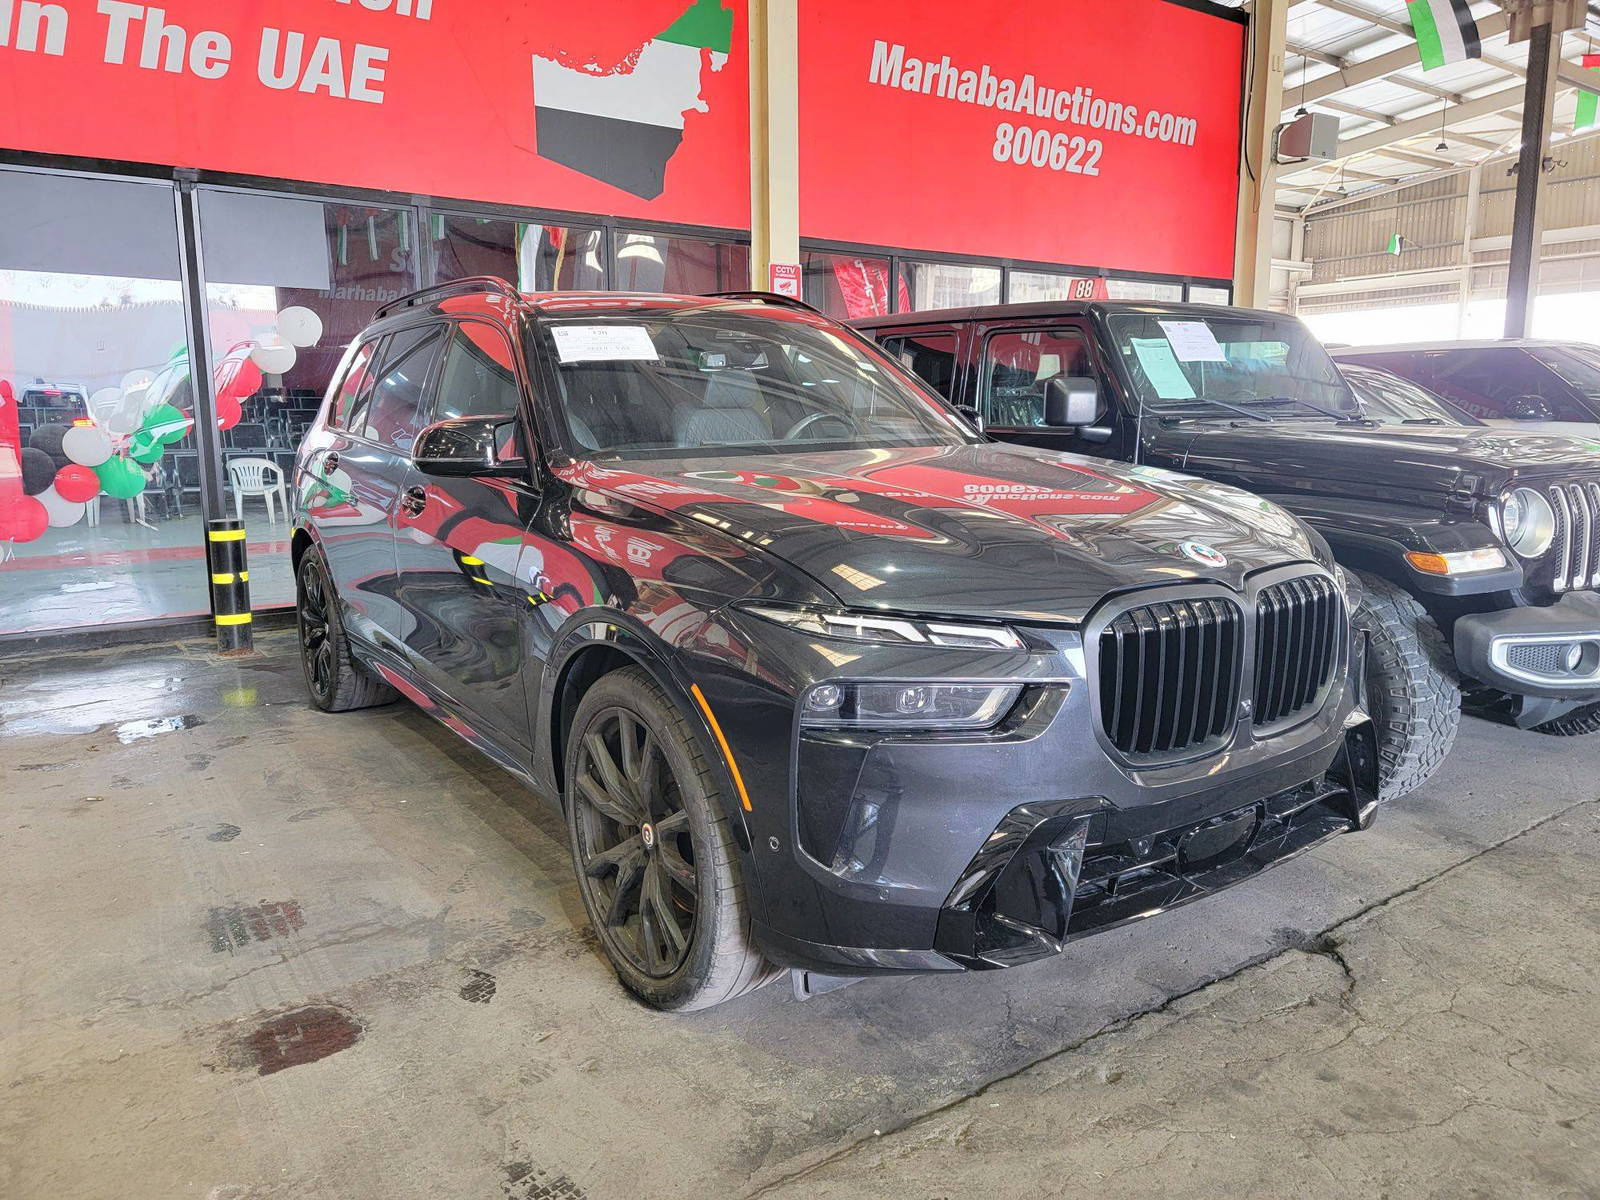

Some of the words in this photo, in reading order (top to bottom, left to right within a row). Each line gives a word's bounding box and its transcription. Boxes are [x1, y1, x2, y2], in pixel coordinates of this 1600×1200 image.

[97, 0, 232, 80] The
[258, 27, 390, 105] UAE
[868, 39, 1197, 146] MarhabaAuctions.com
[993, 122, 1103, 176] 800622
[775, 265, 796, 274] CCTV
[1075, 280, 1094, 298] 88
